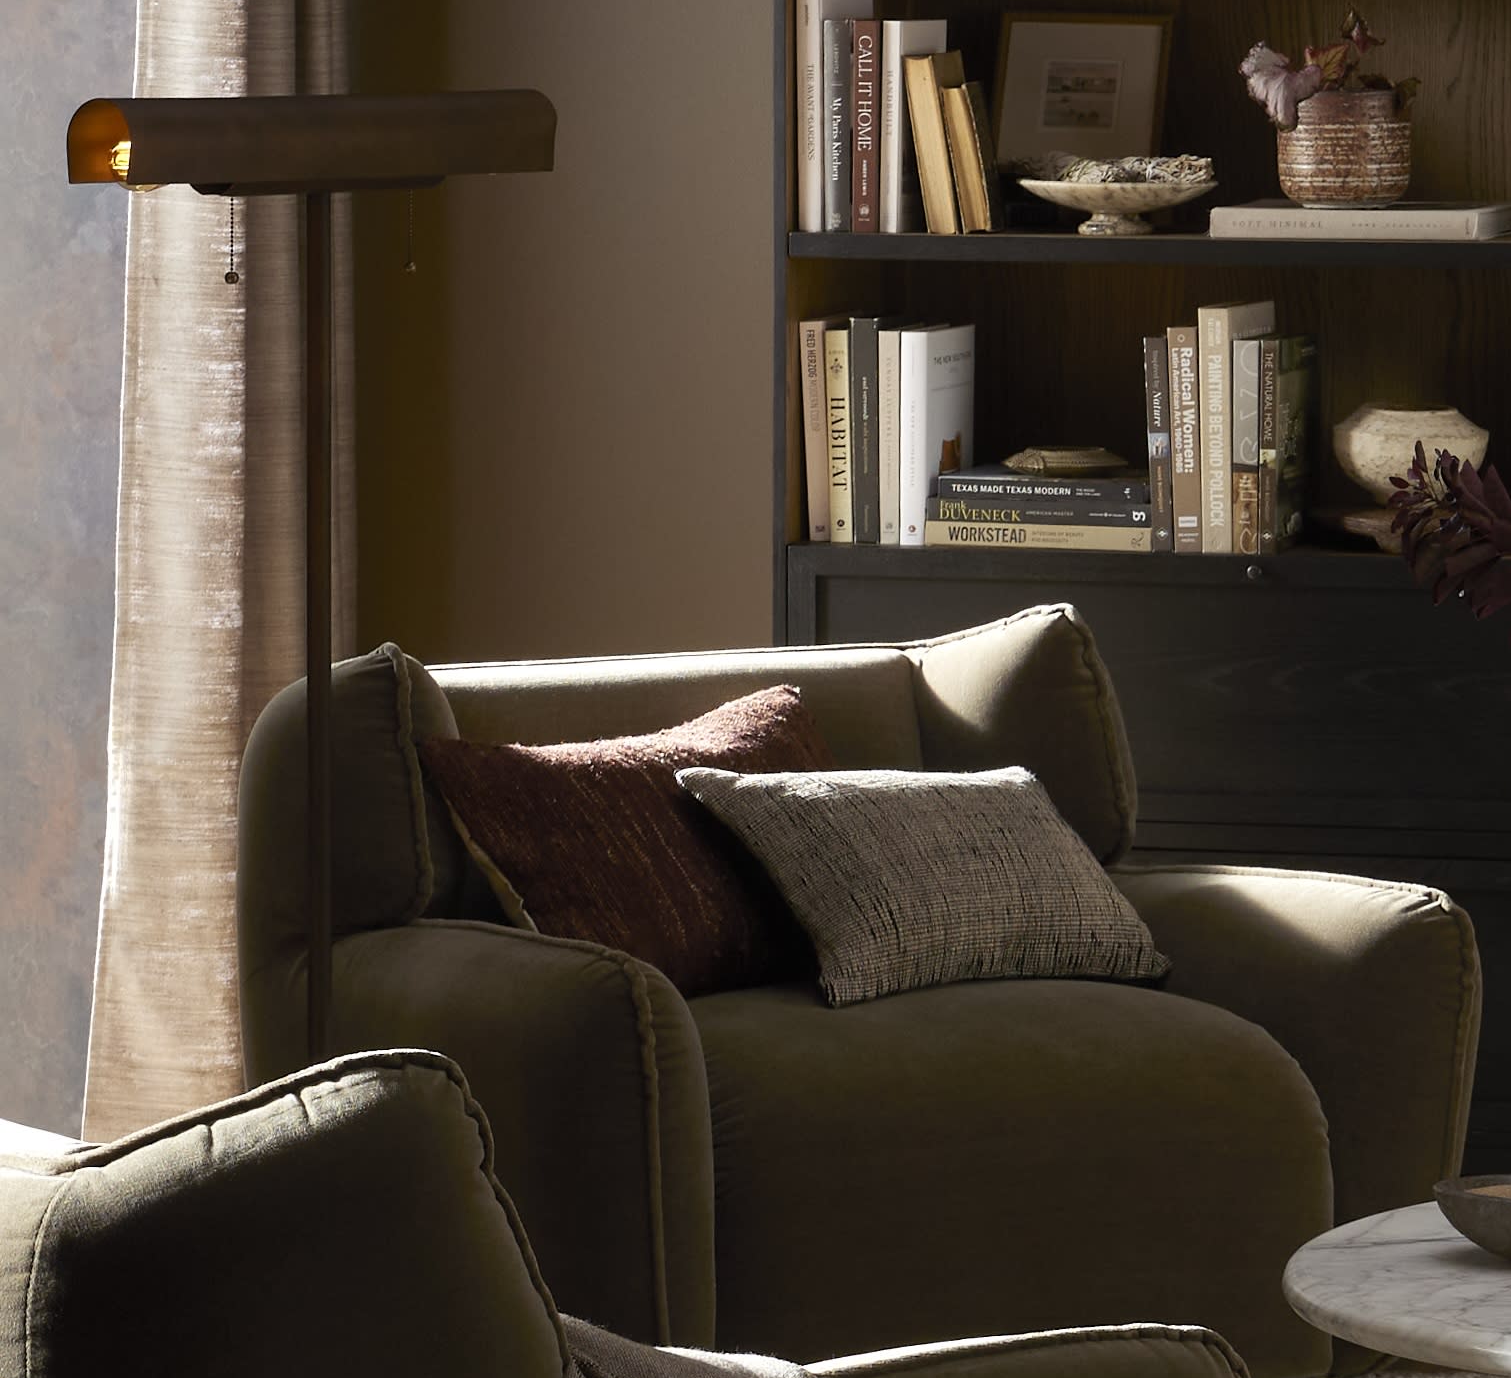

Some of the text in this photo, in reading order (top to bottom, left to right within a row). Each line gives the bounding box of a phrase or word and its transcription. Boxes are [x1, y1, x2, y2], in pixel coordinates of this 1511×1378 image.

[807, 64, 815, 111] THE AVANT
[856, 34, 873, 152] CALL IT HOME
[886, 70, 895, 137] HANDBUILT
[830, 97, 842, 181] My Paris Kitchen
[806, 329, 819, 409] FRED HERZOG MODERN
[1152, 390, 1164, 428] Nature
[1263, 352, 1273, 442] THE NATURAL HOME
[830, 397, 848, 491] HABITAT
[1171, 347, 1183, 473] Latin American Art, 1960-1985
[1180, 347, 1196, 473] Radical Women:
[1208, 354, 1225, 527] PAINTING BEYOND POLLOCK
[939, 508, 1021, 522] DUVENECK
[940, 500, 967, 511] Frank
[951, 483, 978, 493] TEXAS
[980, 484, 1004, 494] MADE
[1006, 485, 1033, 495] TEXAS
[1034, 487, 1071, 496] MODERN
[948, 525, 1027, 543] WORKSTEAD
